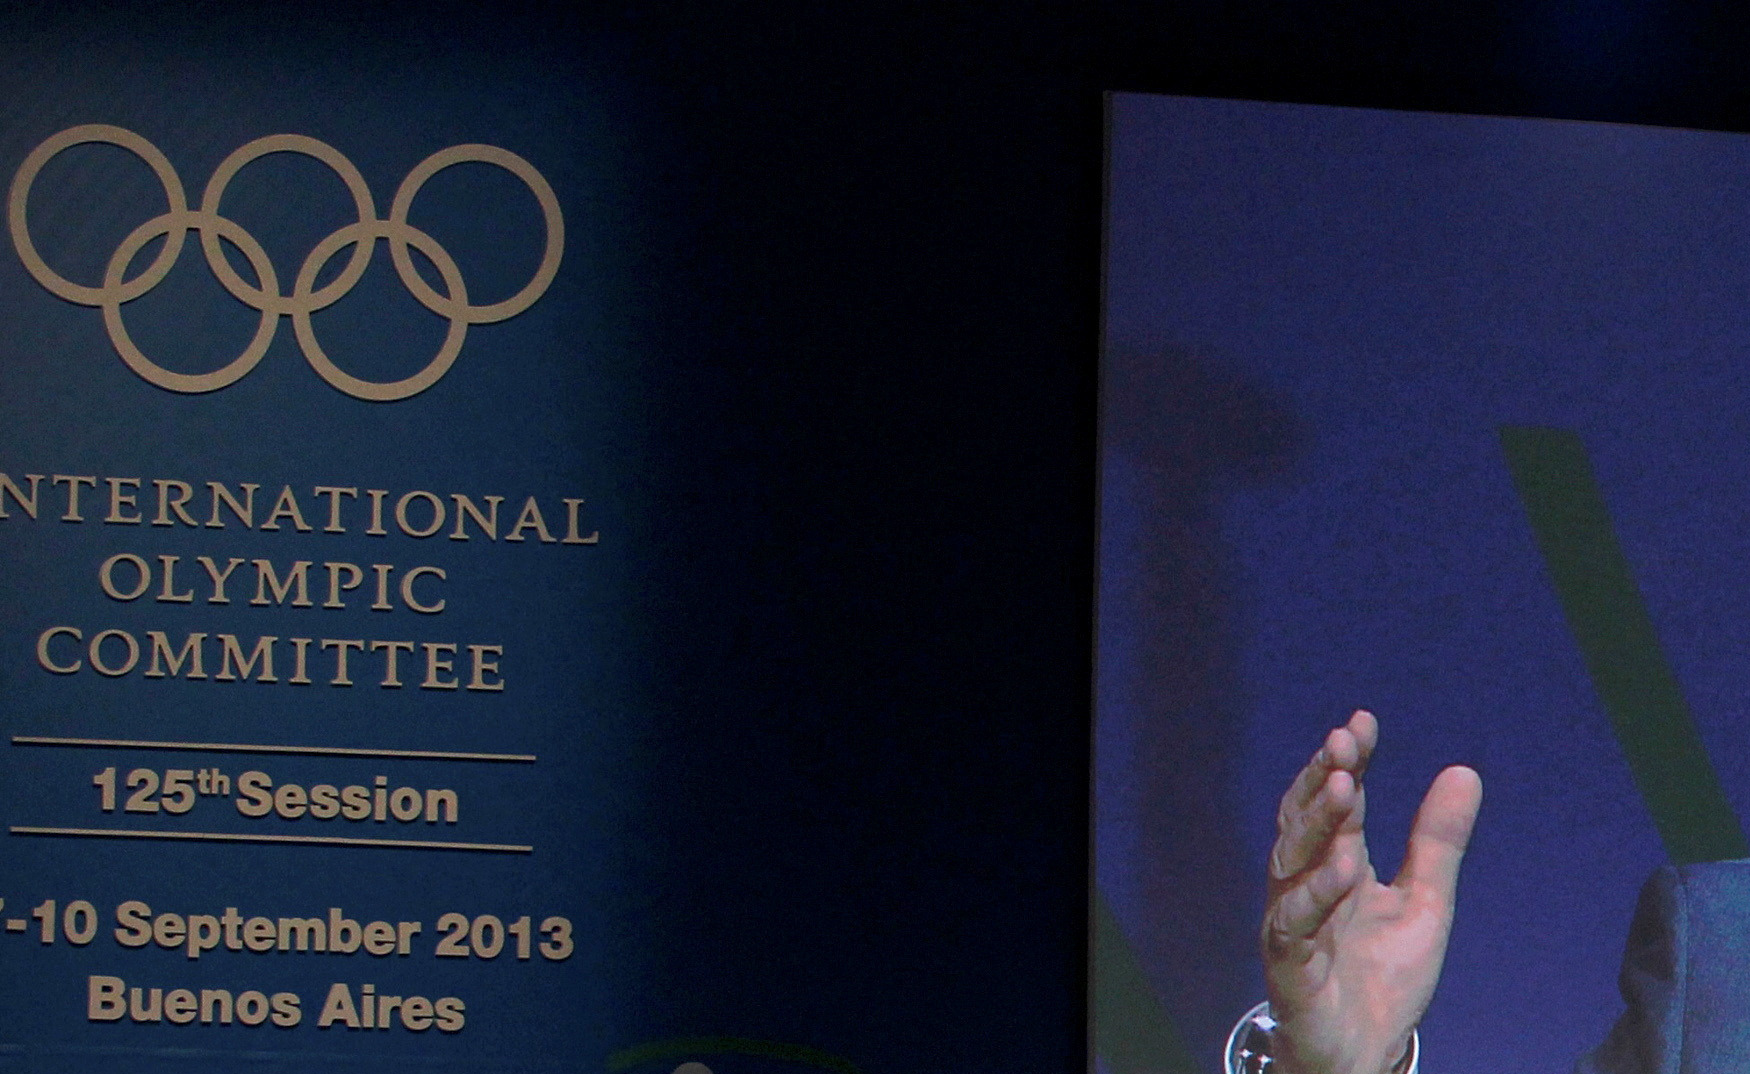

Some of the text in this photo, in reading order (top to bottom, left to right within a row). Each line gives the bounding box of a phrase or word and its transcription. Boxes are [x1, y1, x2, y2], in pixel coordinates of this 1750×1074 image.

[0, 472, 599, 544] NTERNATIONAL
[99, 553, 447, 613] OLYMPIC
[37, 626, 505, 690] COMMITTEE
[93, 767, 458, 822] 125th Session
[0, 898, 574, 960] -10 September 2013
[88, 975, 466, 1031] Buenos Aires
